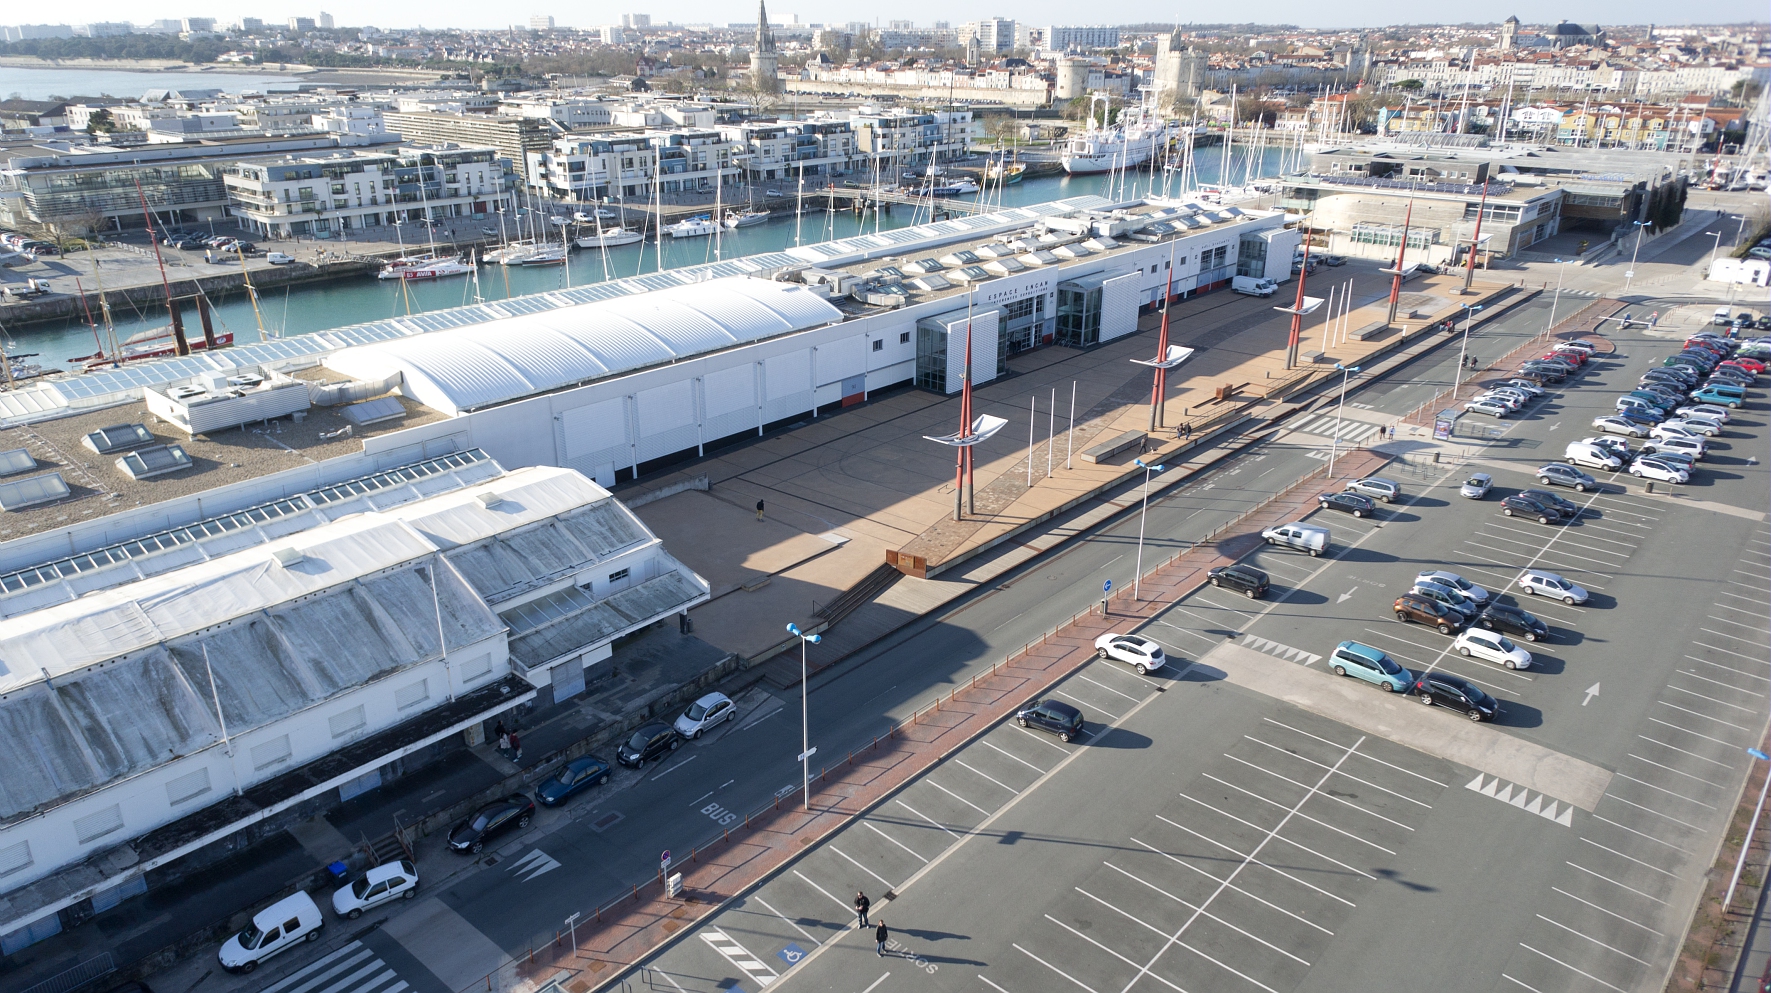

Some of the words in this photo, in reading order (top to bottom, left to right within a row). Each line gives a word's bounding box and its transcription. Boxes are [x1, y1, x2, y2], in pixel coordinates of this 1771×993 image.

[988, 287, 1018, 301] ESPACE
[1025, 280, 1048, 291] ENCAN
[700, 802, 737, 825] BUS
